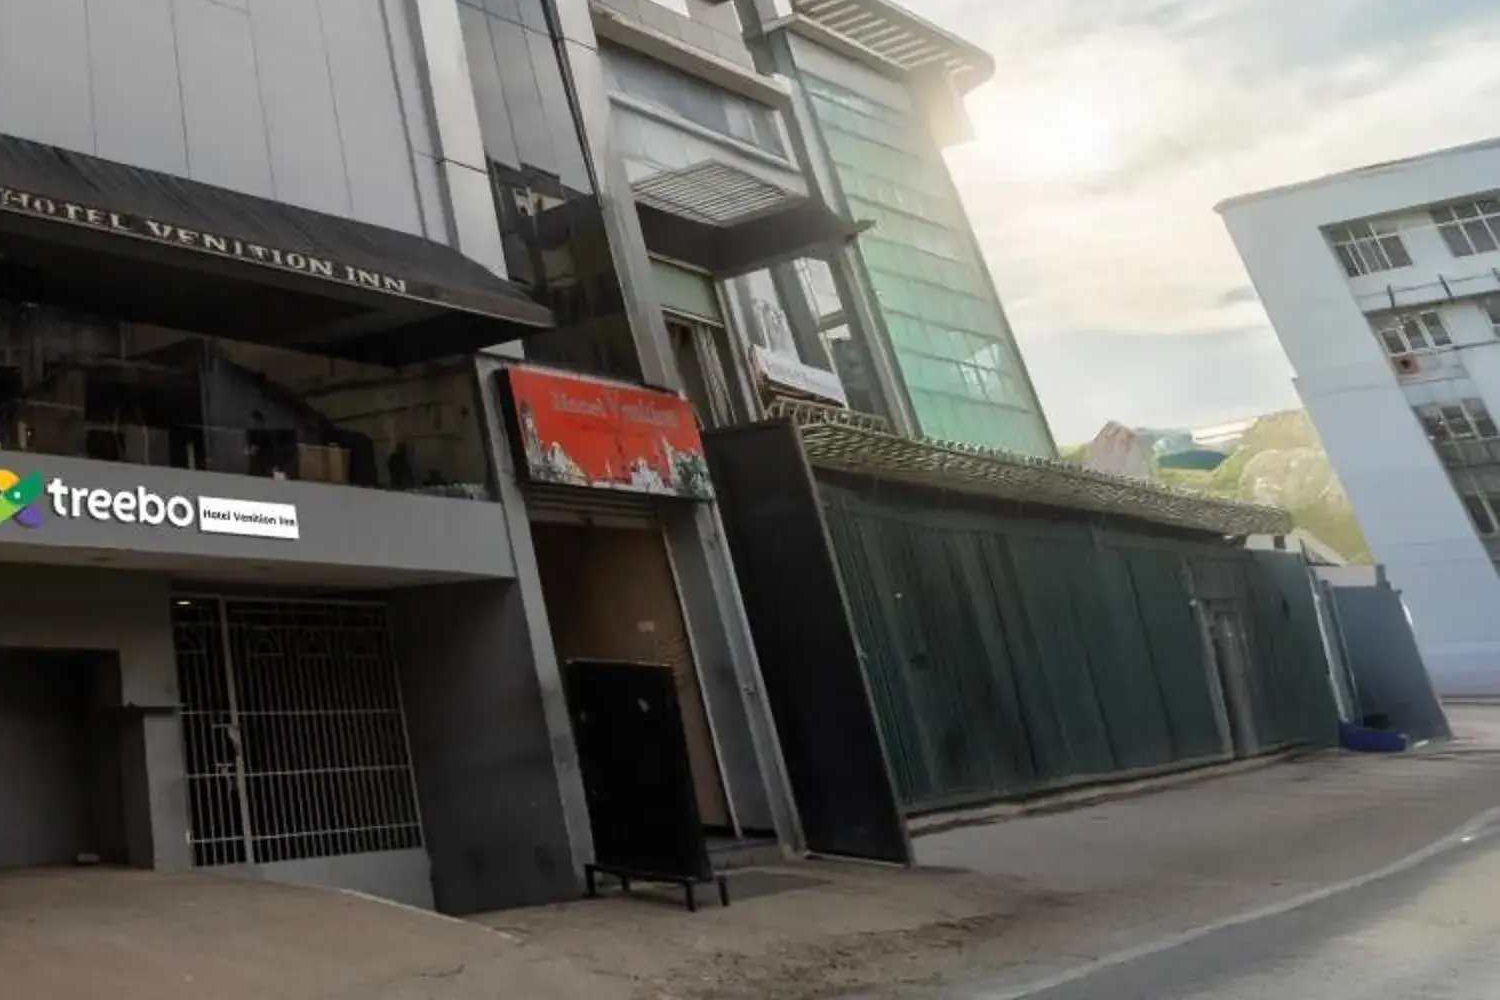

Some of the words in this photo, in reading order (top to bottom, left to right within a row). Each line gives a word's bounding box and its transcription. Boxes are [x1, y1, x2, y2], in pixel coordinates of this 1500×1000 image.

[145, 217, 333, 277] VENITION
[345, 265, 407, 294] INN
[47, 477, 195, 527] treebo
[203, 509, 231, 521] Hotel
